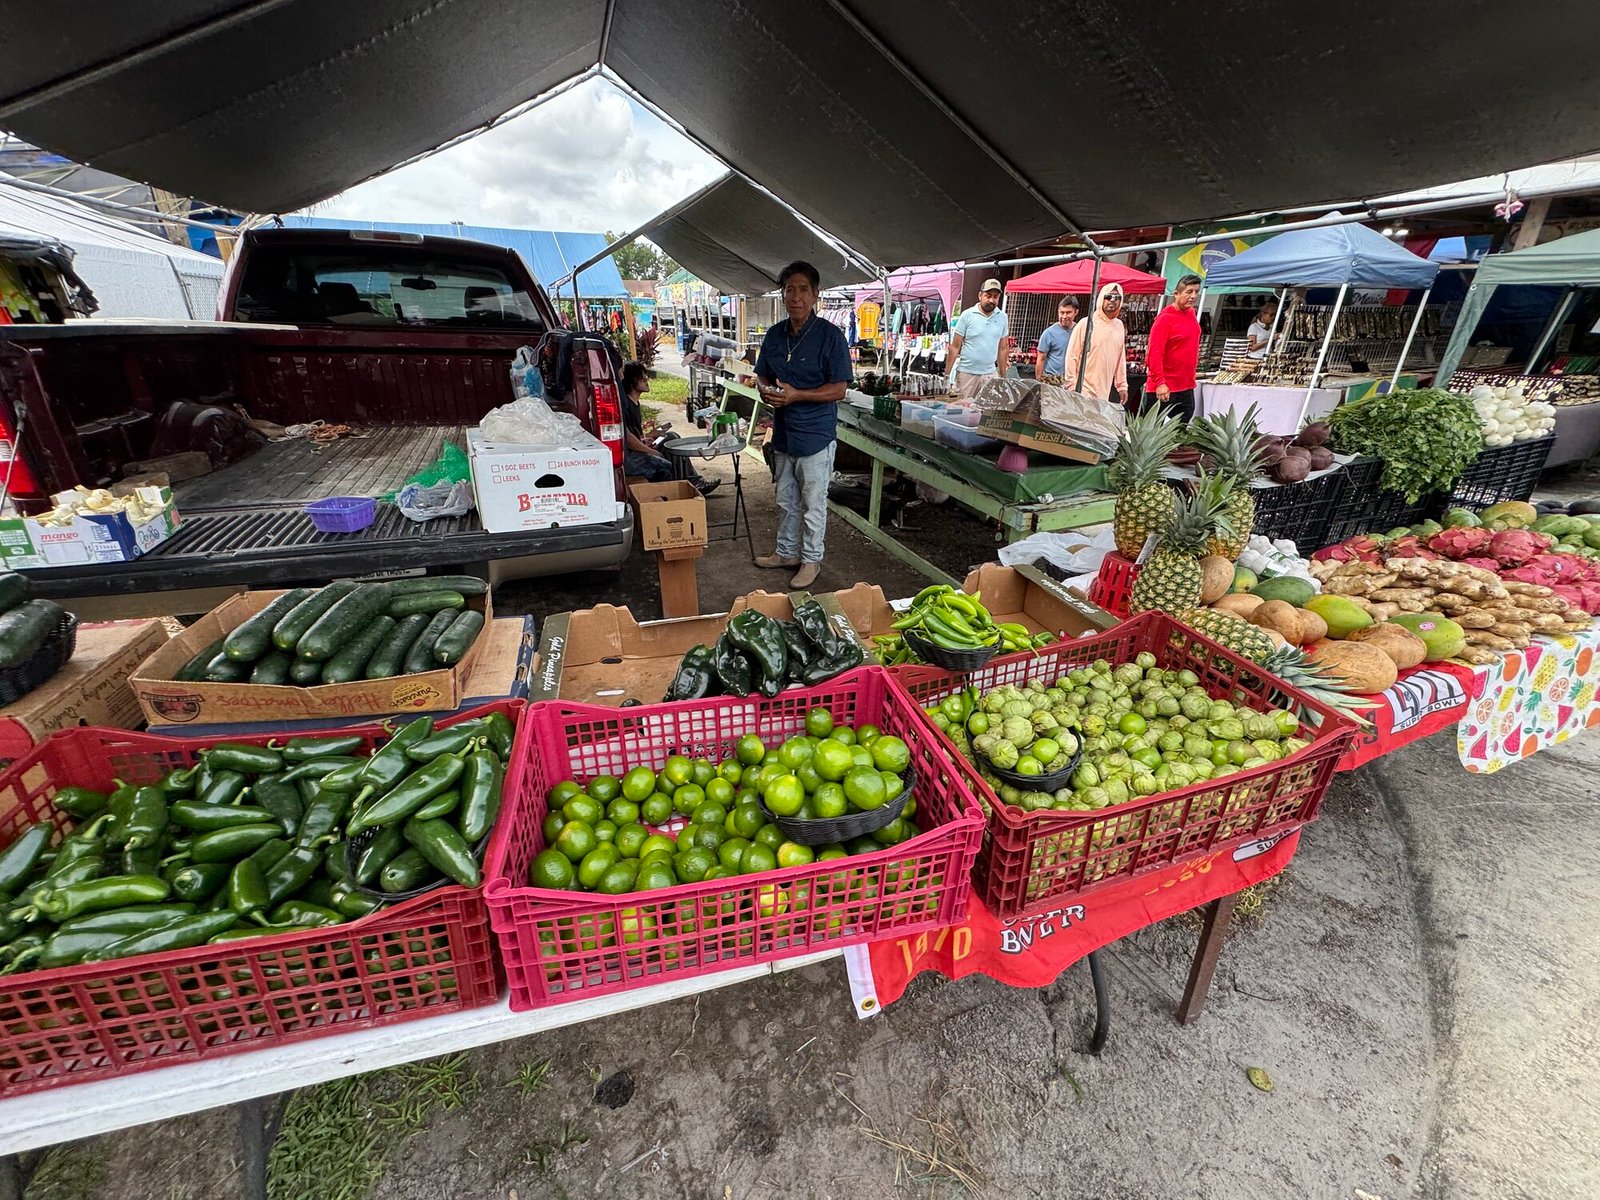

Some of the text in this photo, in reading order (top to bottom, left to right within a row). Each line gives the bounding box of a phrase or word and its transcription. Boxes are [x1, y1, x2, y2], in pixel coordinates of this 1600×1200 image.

[1034, 431, 1060, 443] FRESH
[581, 459, 600, 467] RADISH
[40, 532, 79, 541] mango
[829, 614, 850, 629] Gold
[542, 636, 564, 691] Gold Pineapples
[389, 686, 440, 708] Suncoast
[1427, 699, 1460, 712] BOWL
